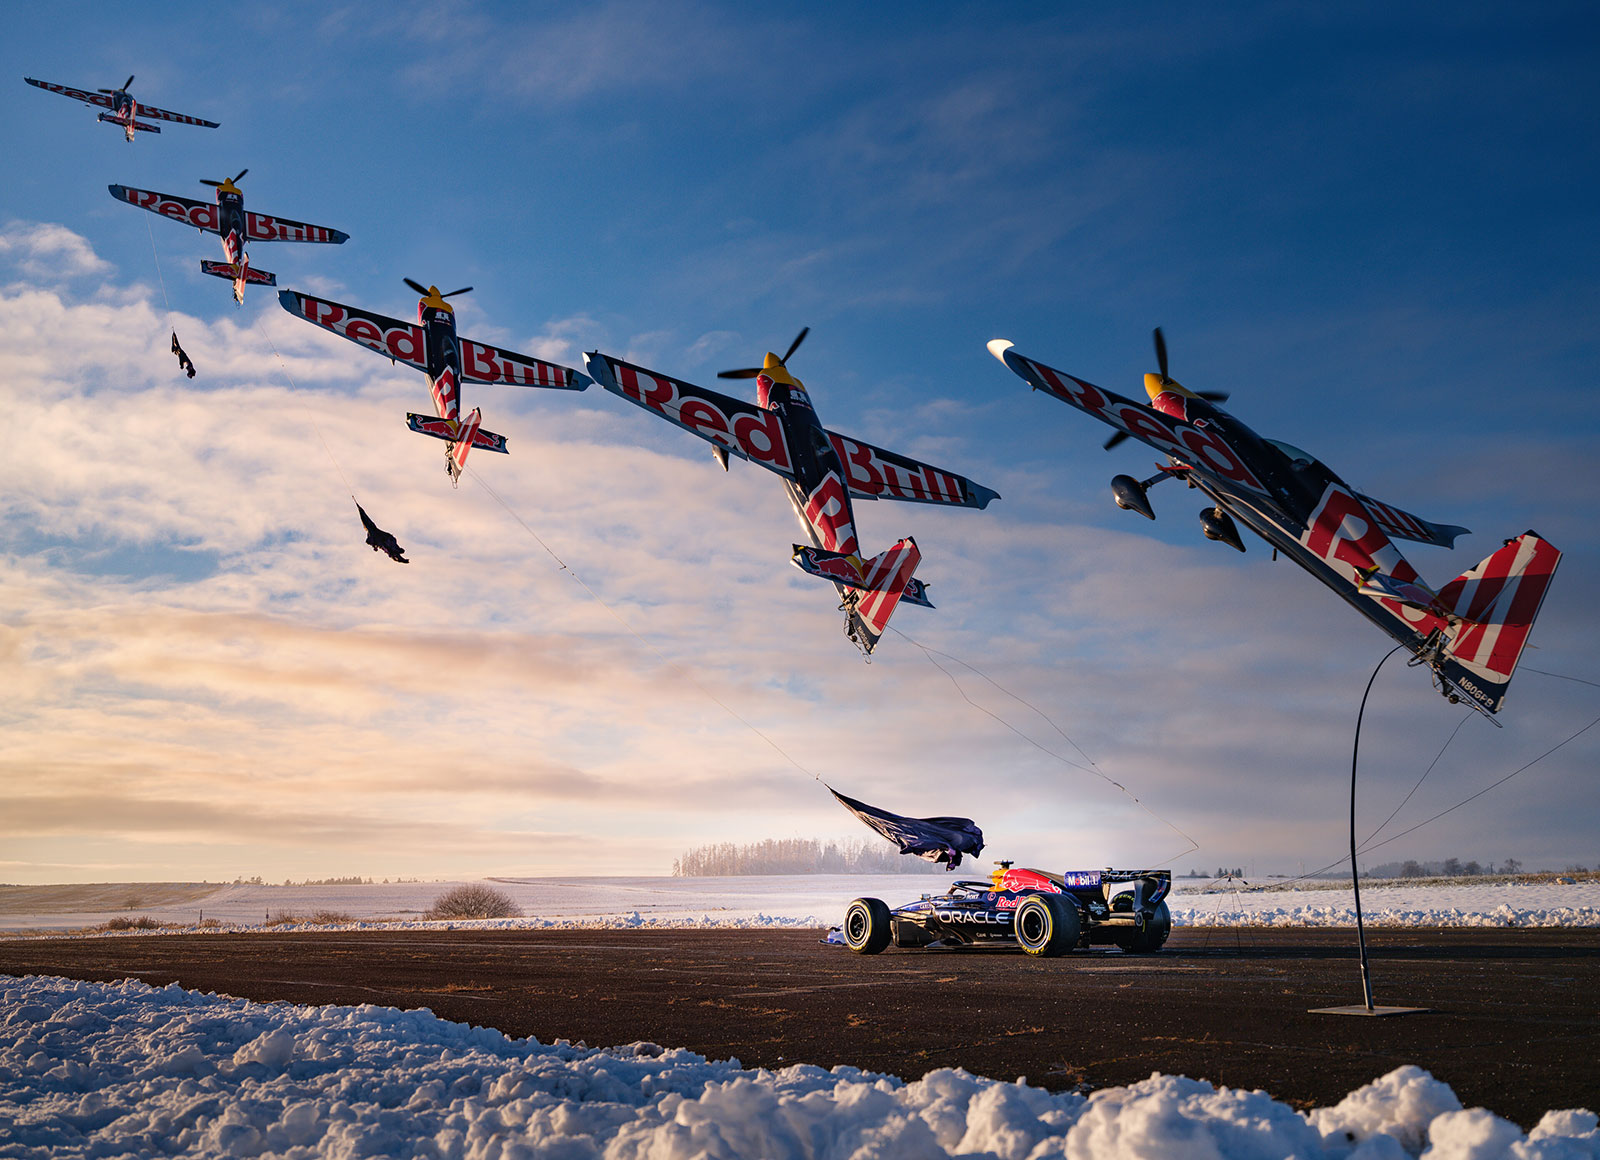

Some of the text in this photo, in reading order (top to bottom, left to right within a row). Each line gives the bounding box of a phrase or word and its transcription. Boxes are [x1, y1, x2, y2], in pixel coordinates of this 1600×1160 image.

[38, 81, 205, 126] Red Bull
[126, 188, 329, 242] Red Bull
[301, 298, 568, 388] Red Bull
[614, 364, 965, 504] Red Bull
[1027, 359, 1271, 497] Red
[995, 895, 1019, 908] Red
[1068, 875, 1090, 886] Mobil
[939, 911, 1010, 925] ORACLE
